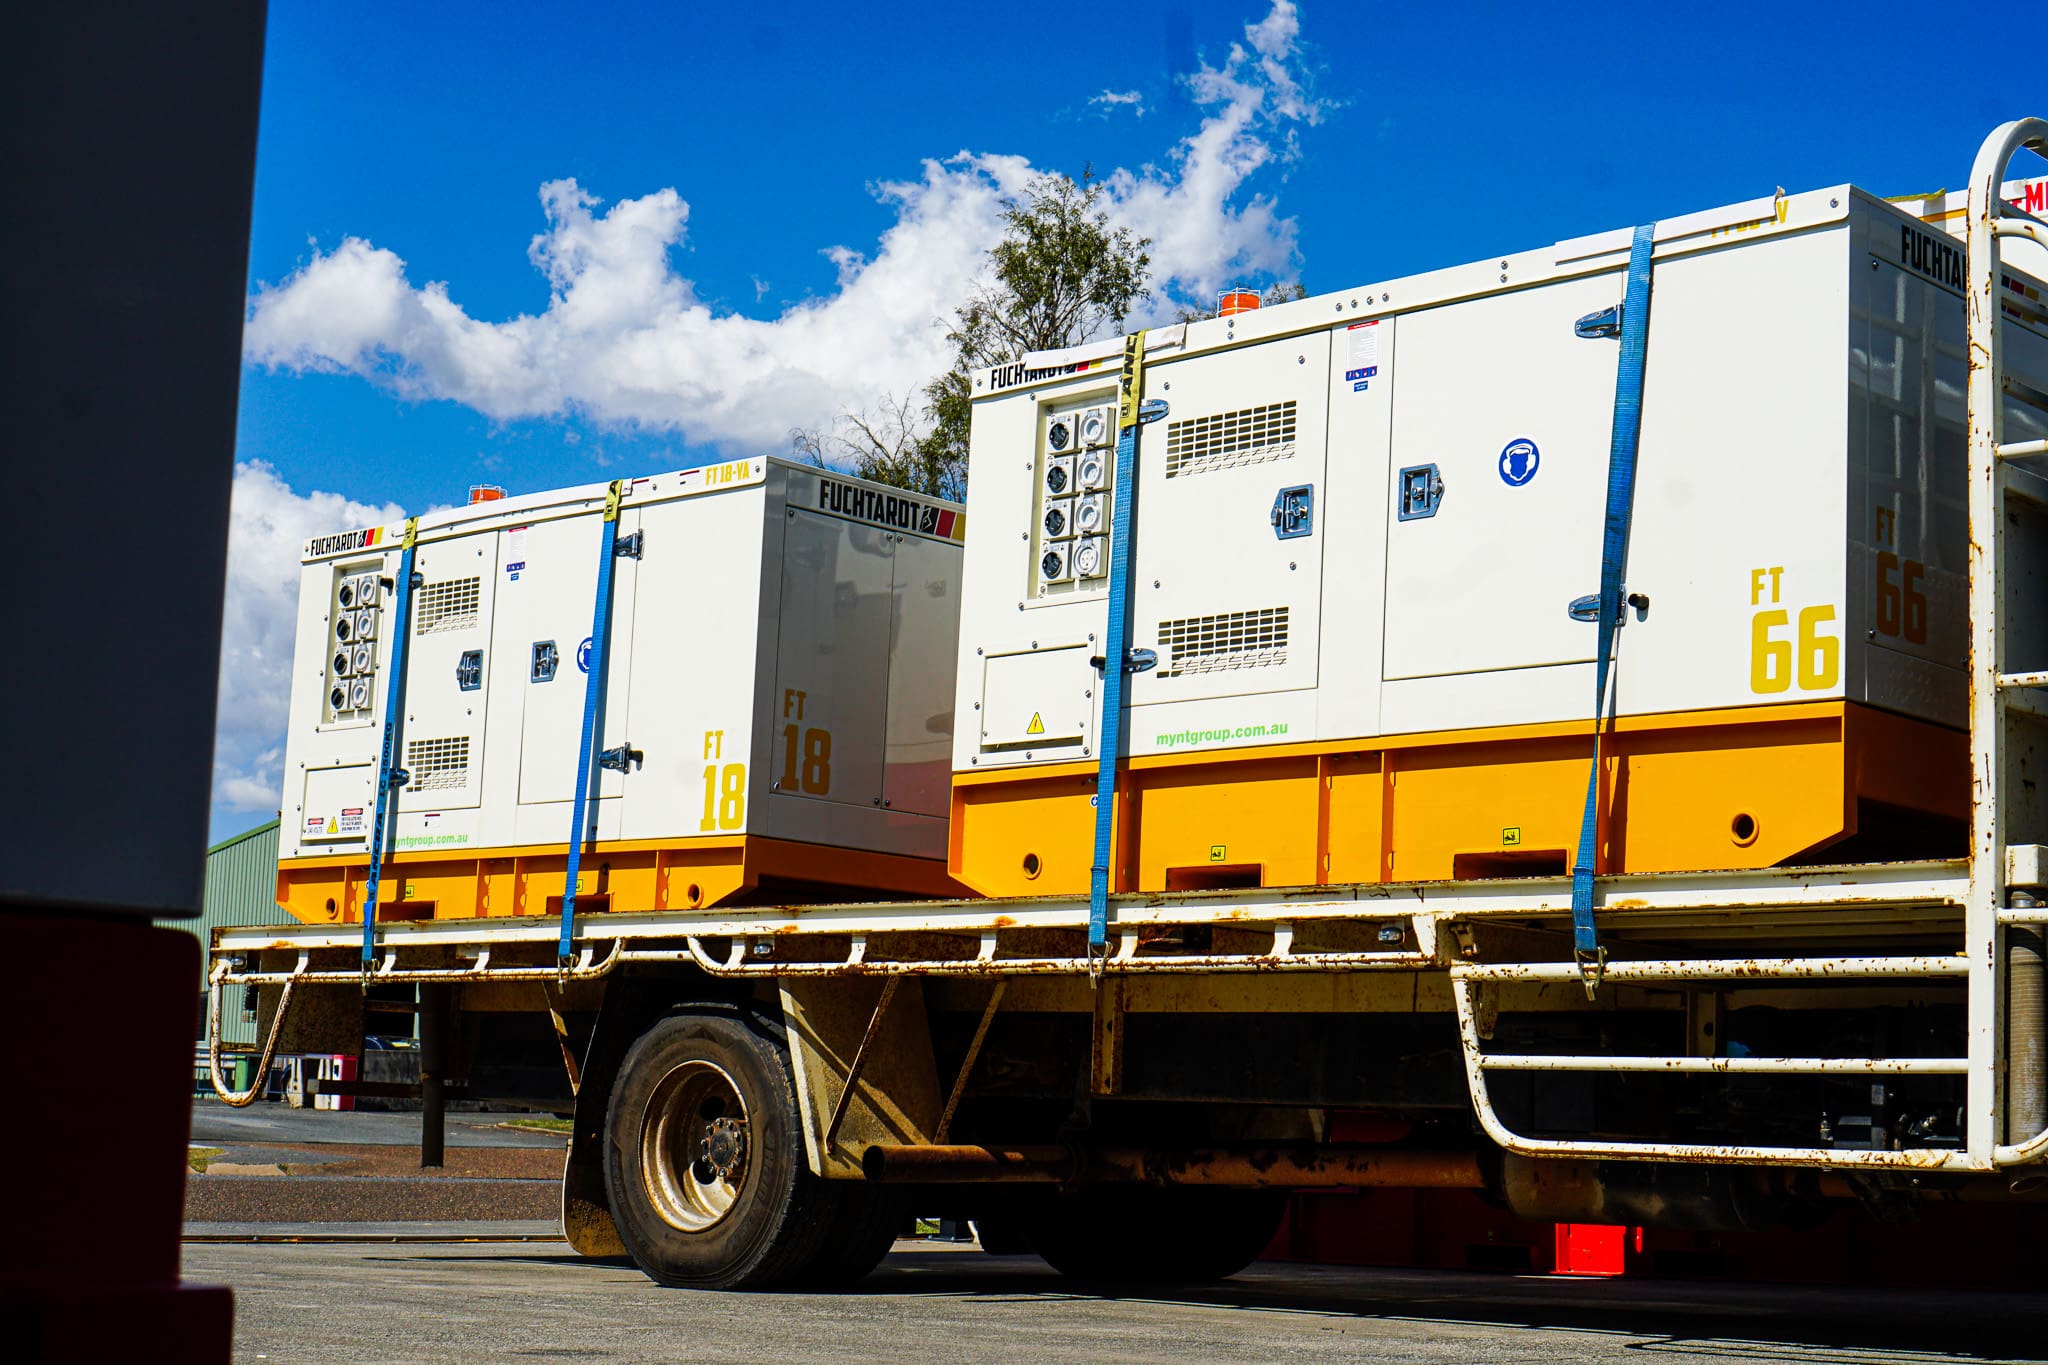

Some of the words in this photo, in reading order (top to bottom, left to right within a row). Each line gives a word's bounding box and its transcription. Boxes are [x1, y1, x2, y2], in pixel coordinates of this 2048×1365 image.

[1901, 224, 1967, 294] FUCHTA
[820, 479, 920, 531] FUCHTARDT
[1875, 505, 1896, 547] FT
[310, 531, 358, 557] FUCHTARDT
[1751, 566, 1785, 606] FT
[1875, 551, 1928, 646] 66
[1750, 604, 1840, 695] 66
[783, 688, 807, 721] FT
[703, 729, 725, 760] FT
[1156, 723, 1289, 747] myntgroup.com.au
[779, 723, 832, 796] 18
[699, 762, 746, 832] 18
